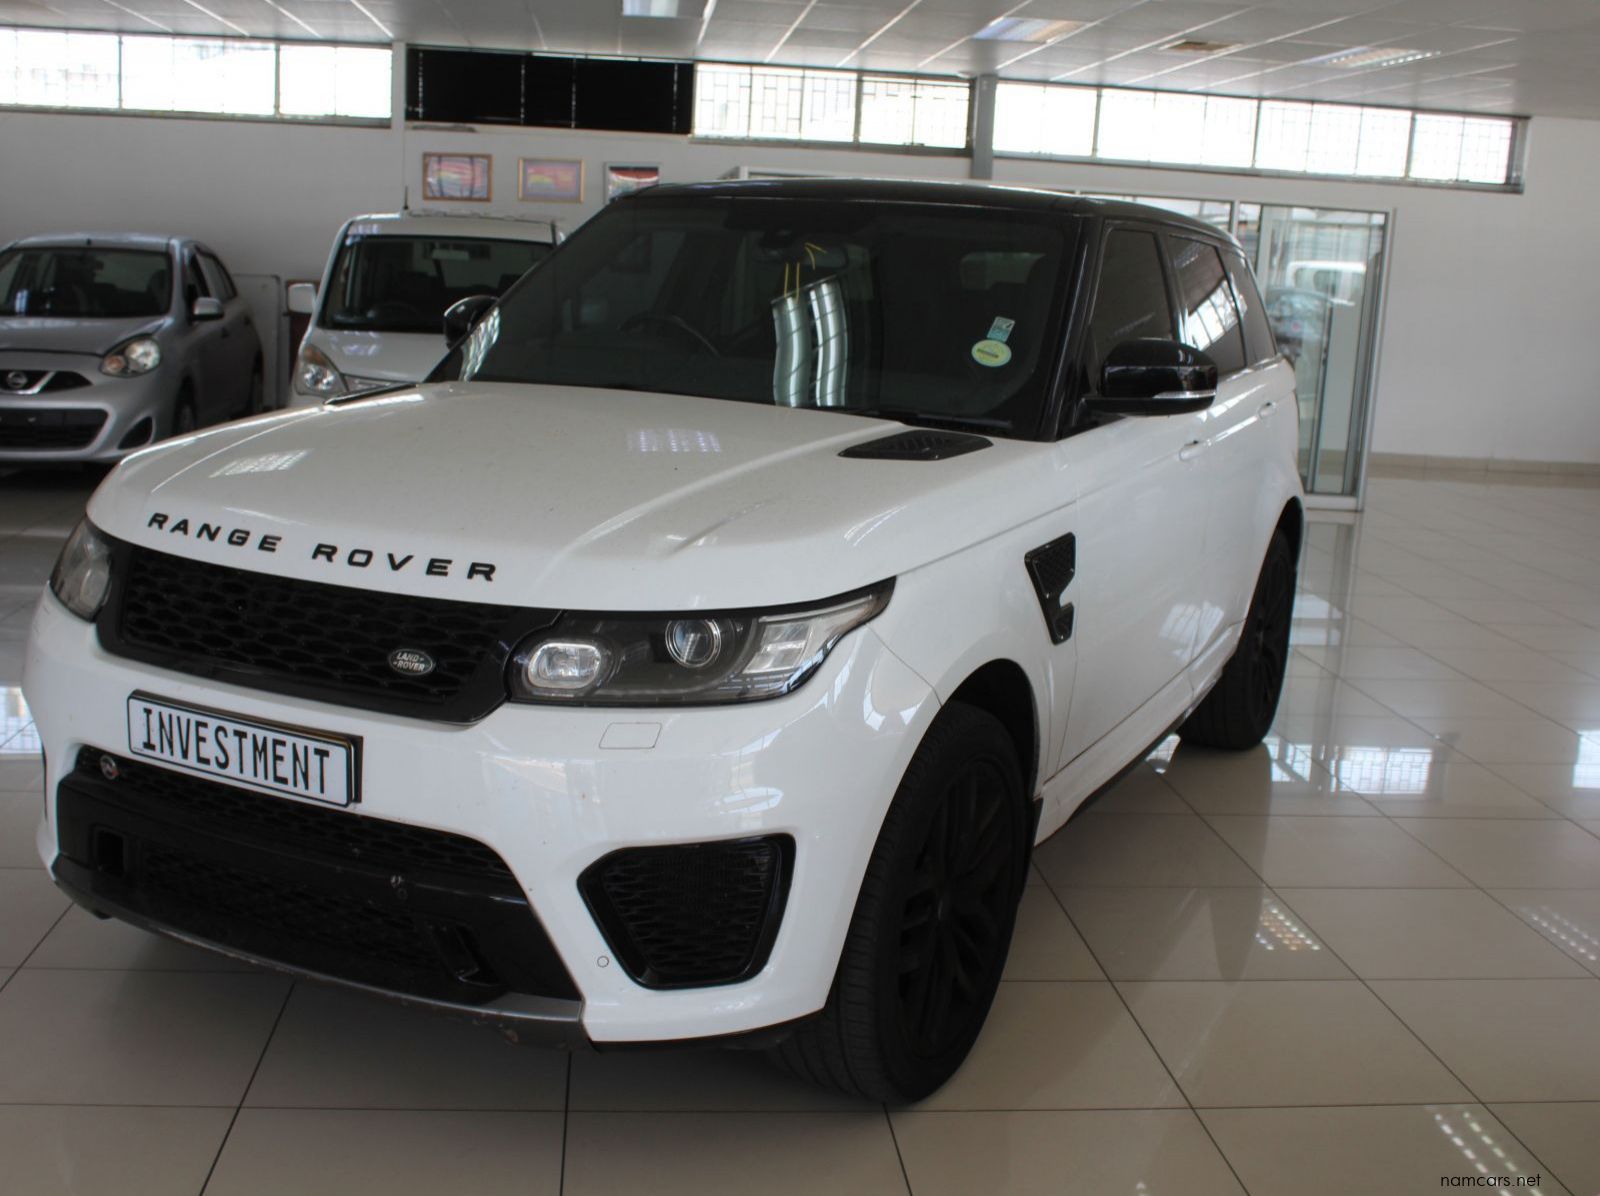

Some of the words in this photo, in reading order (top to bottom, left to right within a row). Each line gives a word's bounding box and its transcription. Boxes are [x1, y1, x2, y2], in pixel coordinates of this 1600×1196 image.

[148, 512, 282, 553] RANGE
[311, 543, 496, 582] ROVER
[142, 707, 330, 794] INVESTMENT
